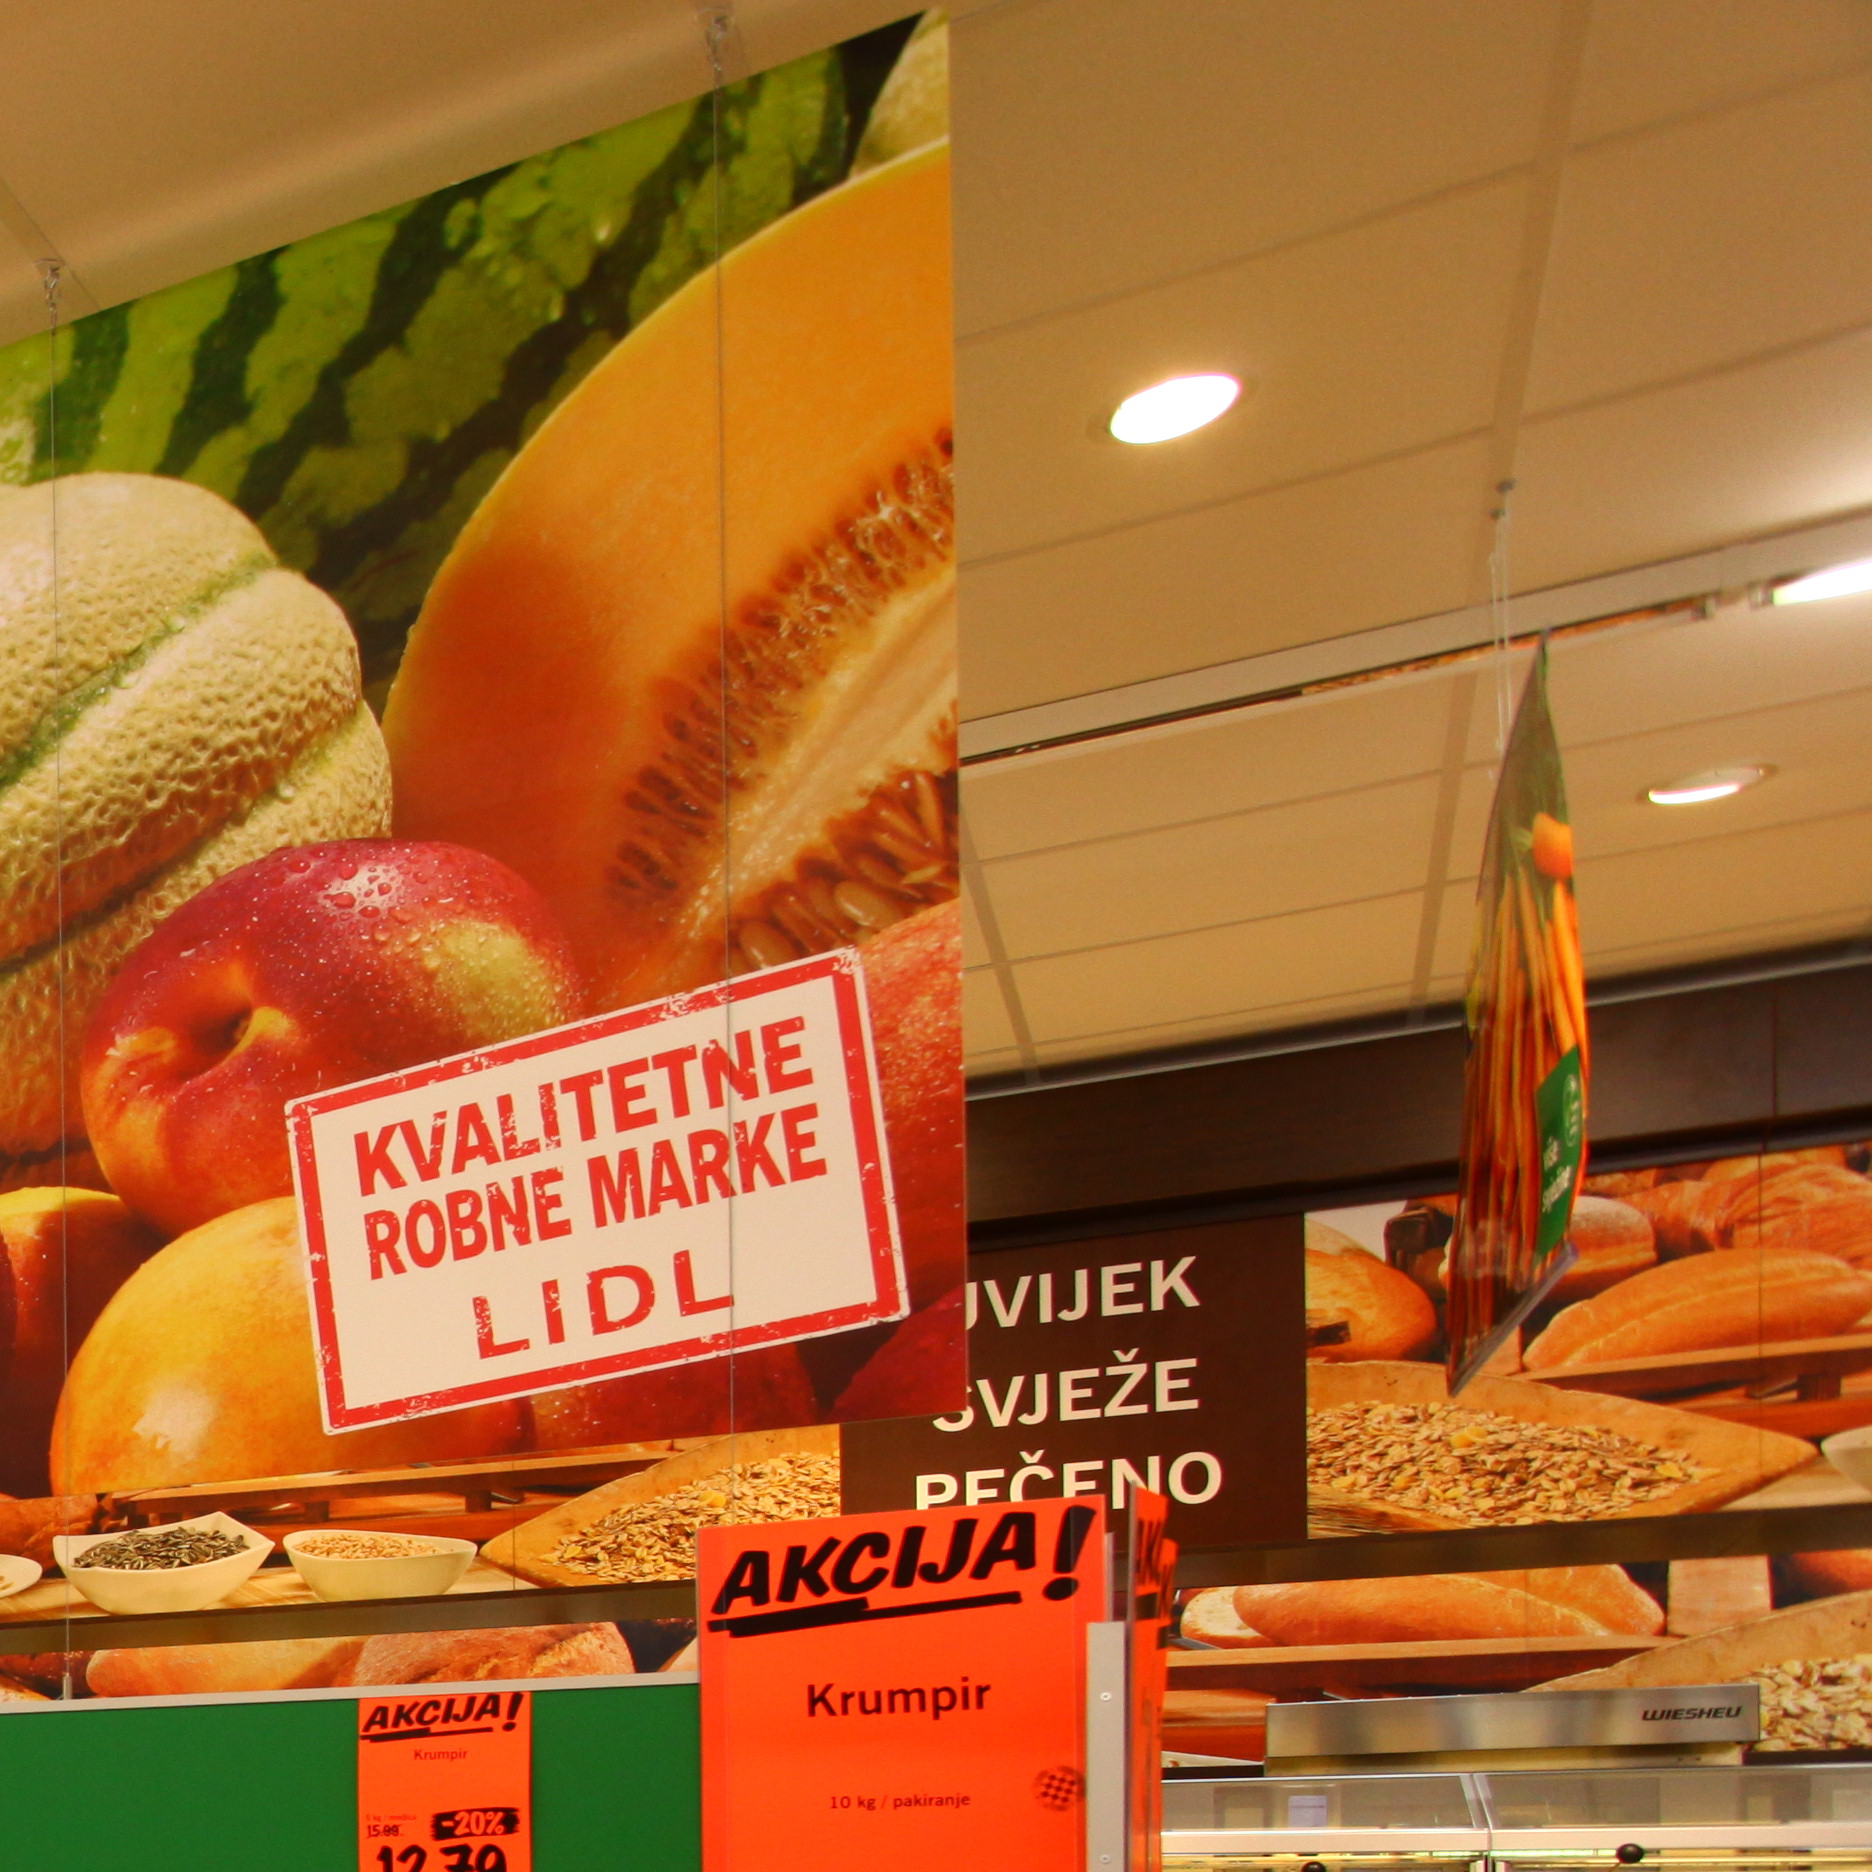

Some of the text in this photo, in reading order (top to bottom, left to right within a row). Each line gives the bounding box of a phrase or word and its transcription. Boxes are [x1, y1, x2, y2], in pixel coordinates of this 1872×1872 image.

[354, 1016, 814, 1197] KVALITETNE
[364, 1103, 827, 1280] ROBNE MARKE
[472, 1250, 734, 1359] LIDL
[712, 1506, 1095, 1614] AKCIJA!
[362, 1693, 524, 1732] AKCIJA!
[806, 1678, 991, 1720] Krumpir
[1642, 1706, 1742, 1722] WIESHEU
[414, 1749, 467, 1761] Krumpir
[830, 1795, 851, 1810] 10
[856, 1795, 877, 1812] kg
[892, 1792, 971, 1810] pakiranje
[442, 1811, 503, 1835] -20%
